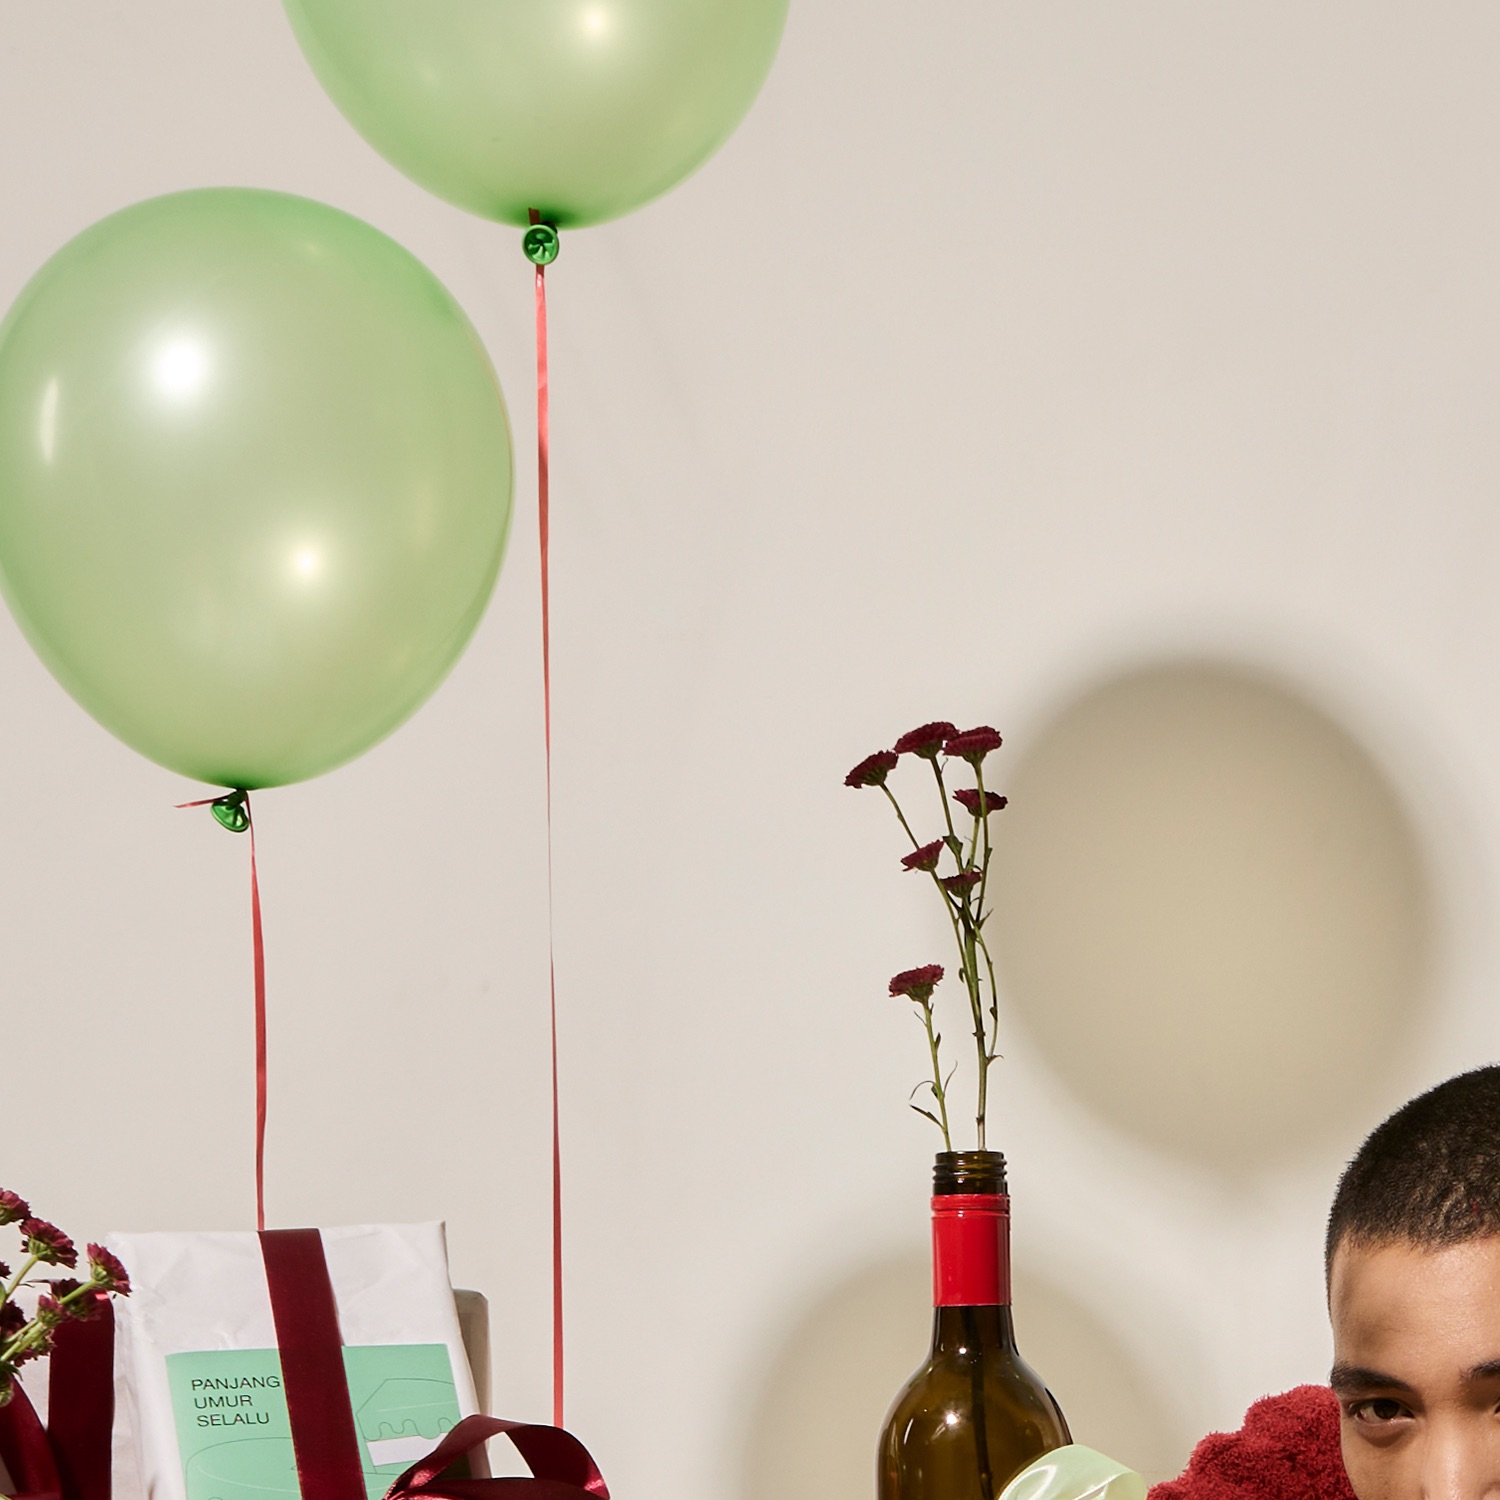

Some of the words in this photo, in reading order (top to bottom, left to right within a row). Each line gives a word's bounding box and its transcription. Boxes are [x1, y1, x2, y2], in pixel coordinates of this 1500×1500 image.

[191, 1376, 281, 1391] PANJANG
[194, 1395, 253, 1409] UMUR
[197, 1412, 270, 1427] SELALU
